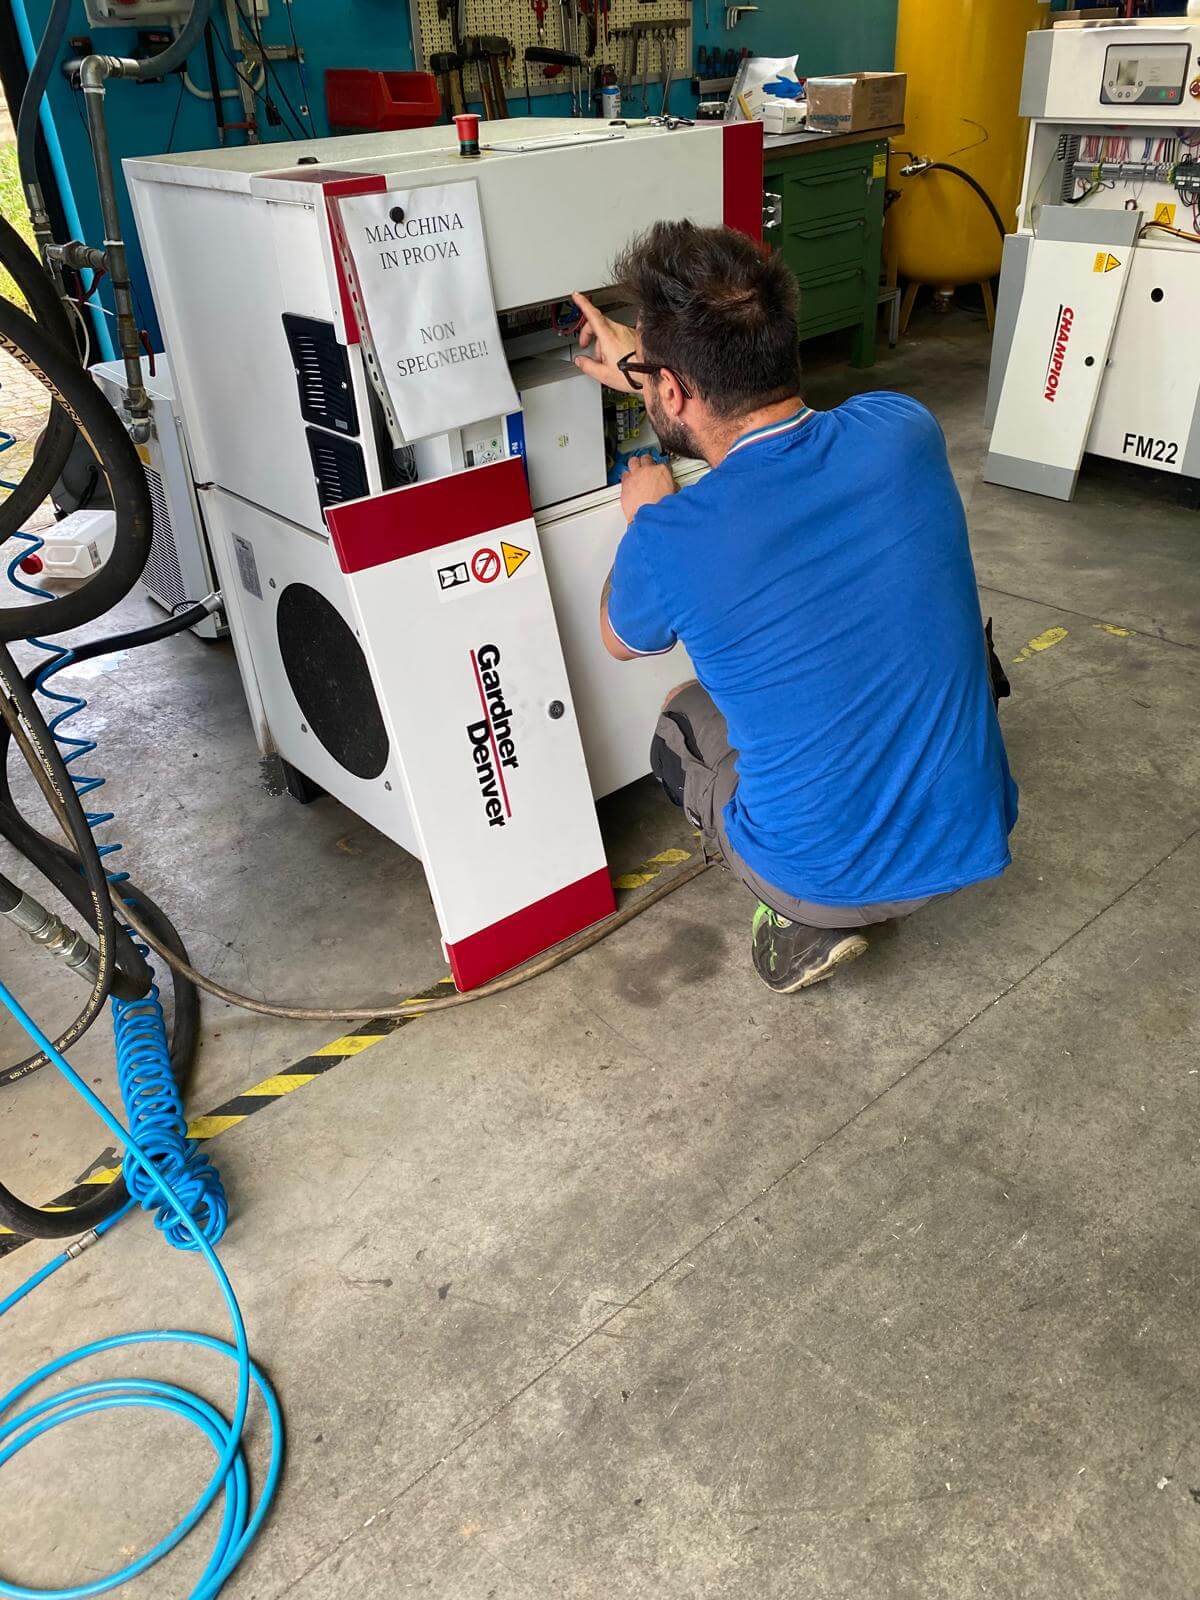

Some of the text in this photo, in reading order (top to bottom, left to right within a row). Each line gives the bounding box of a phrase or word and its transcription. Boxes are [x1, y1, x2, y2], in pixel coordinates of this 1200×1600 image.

[364, 212, 464, 244] MACCHINA
[379, 240, 461, 270] IN PROVA
[419, 321, 456, 344] NON
[396, 339, 489, 377] SPEGNERE!!
[1044, 307, 1074, 402] CHAMPION
[1122, 432, 1179, 465] FM22
[477, 644, 519, 769] Gardner
[466, 720, 506, 827] Denver
